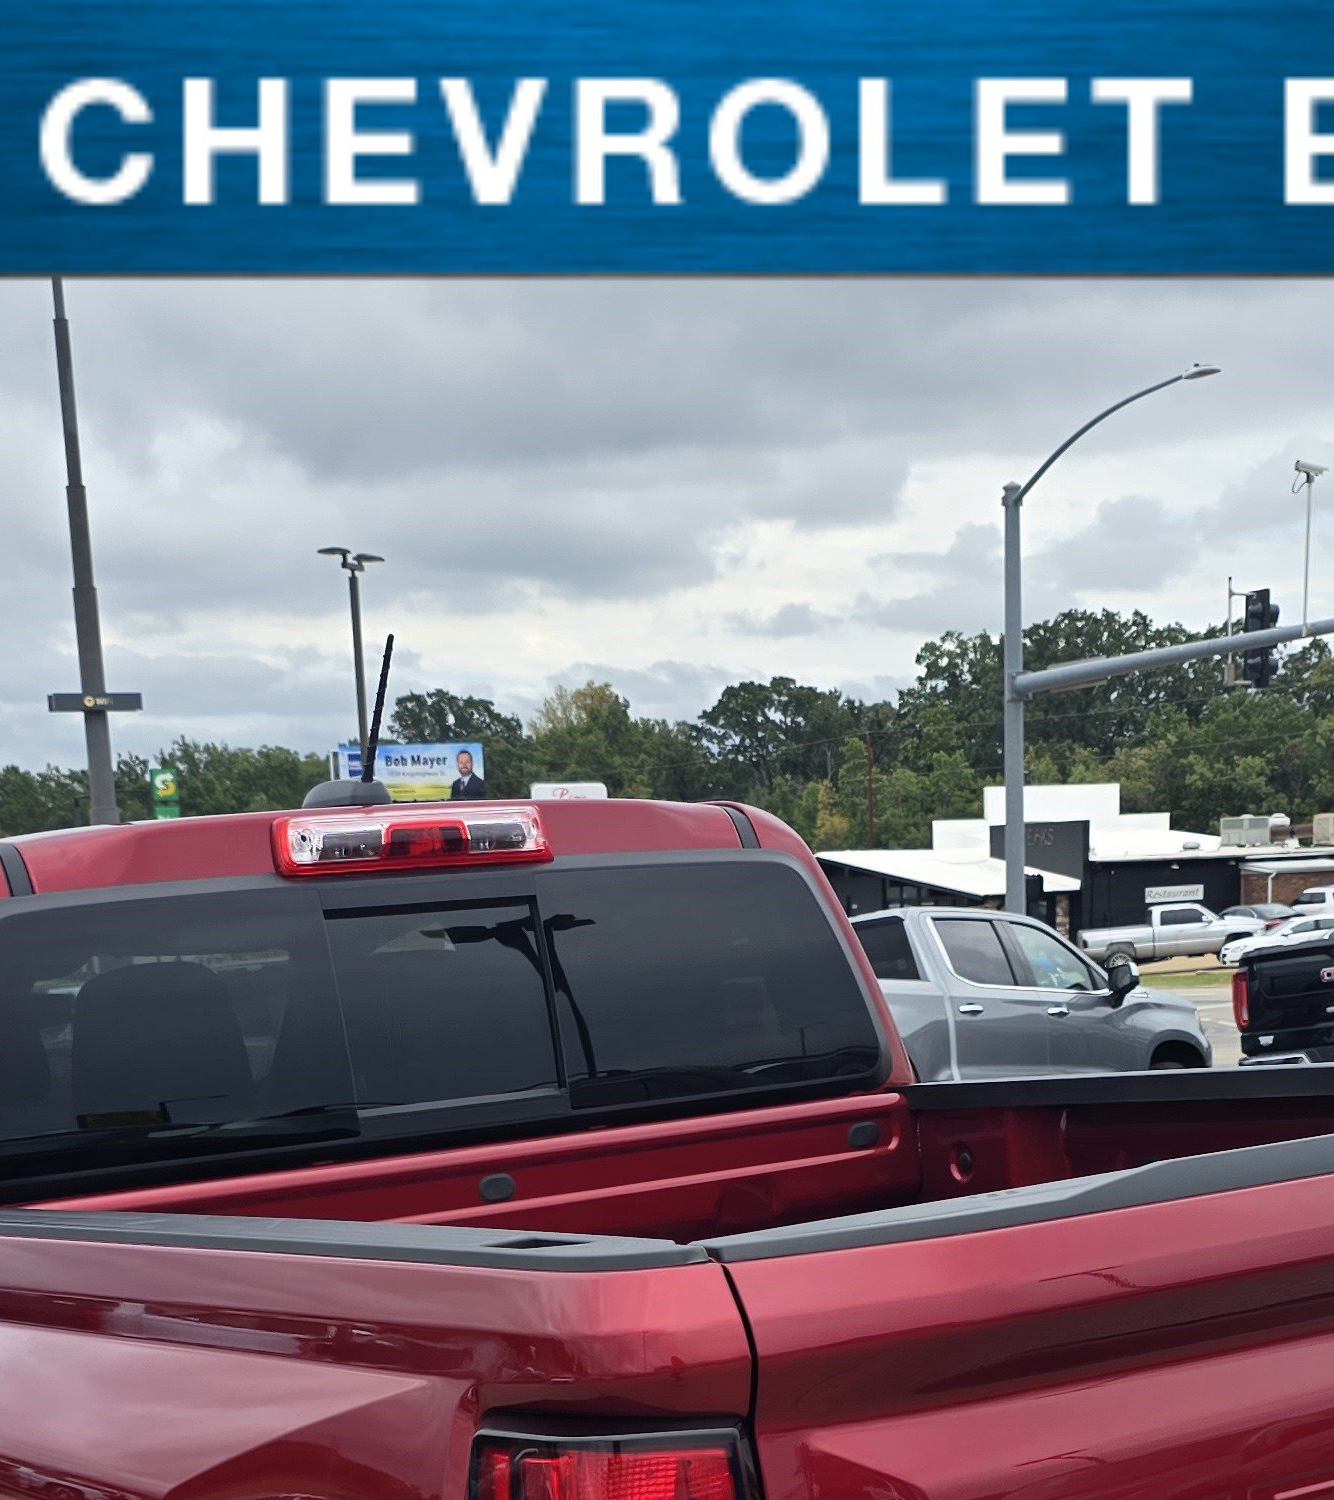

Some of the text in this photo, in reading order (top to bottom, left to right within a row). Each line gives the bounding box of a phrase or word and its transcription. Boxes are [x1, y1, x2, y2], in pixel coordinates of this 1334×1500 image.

[384, 755, 448, 769] Bob Mayer
[1146, 886, 1200, 900] Restaurant
